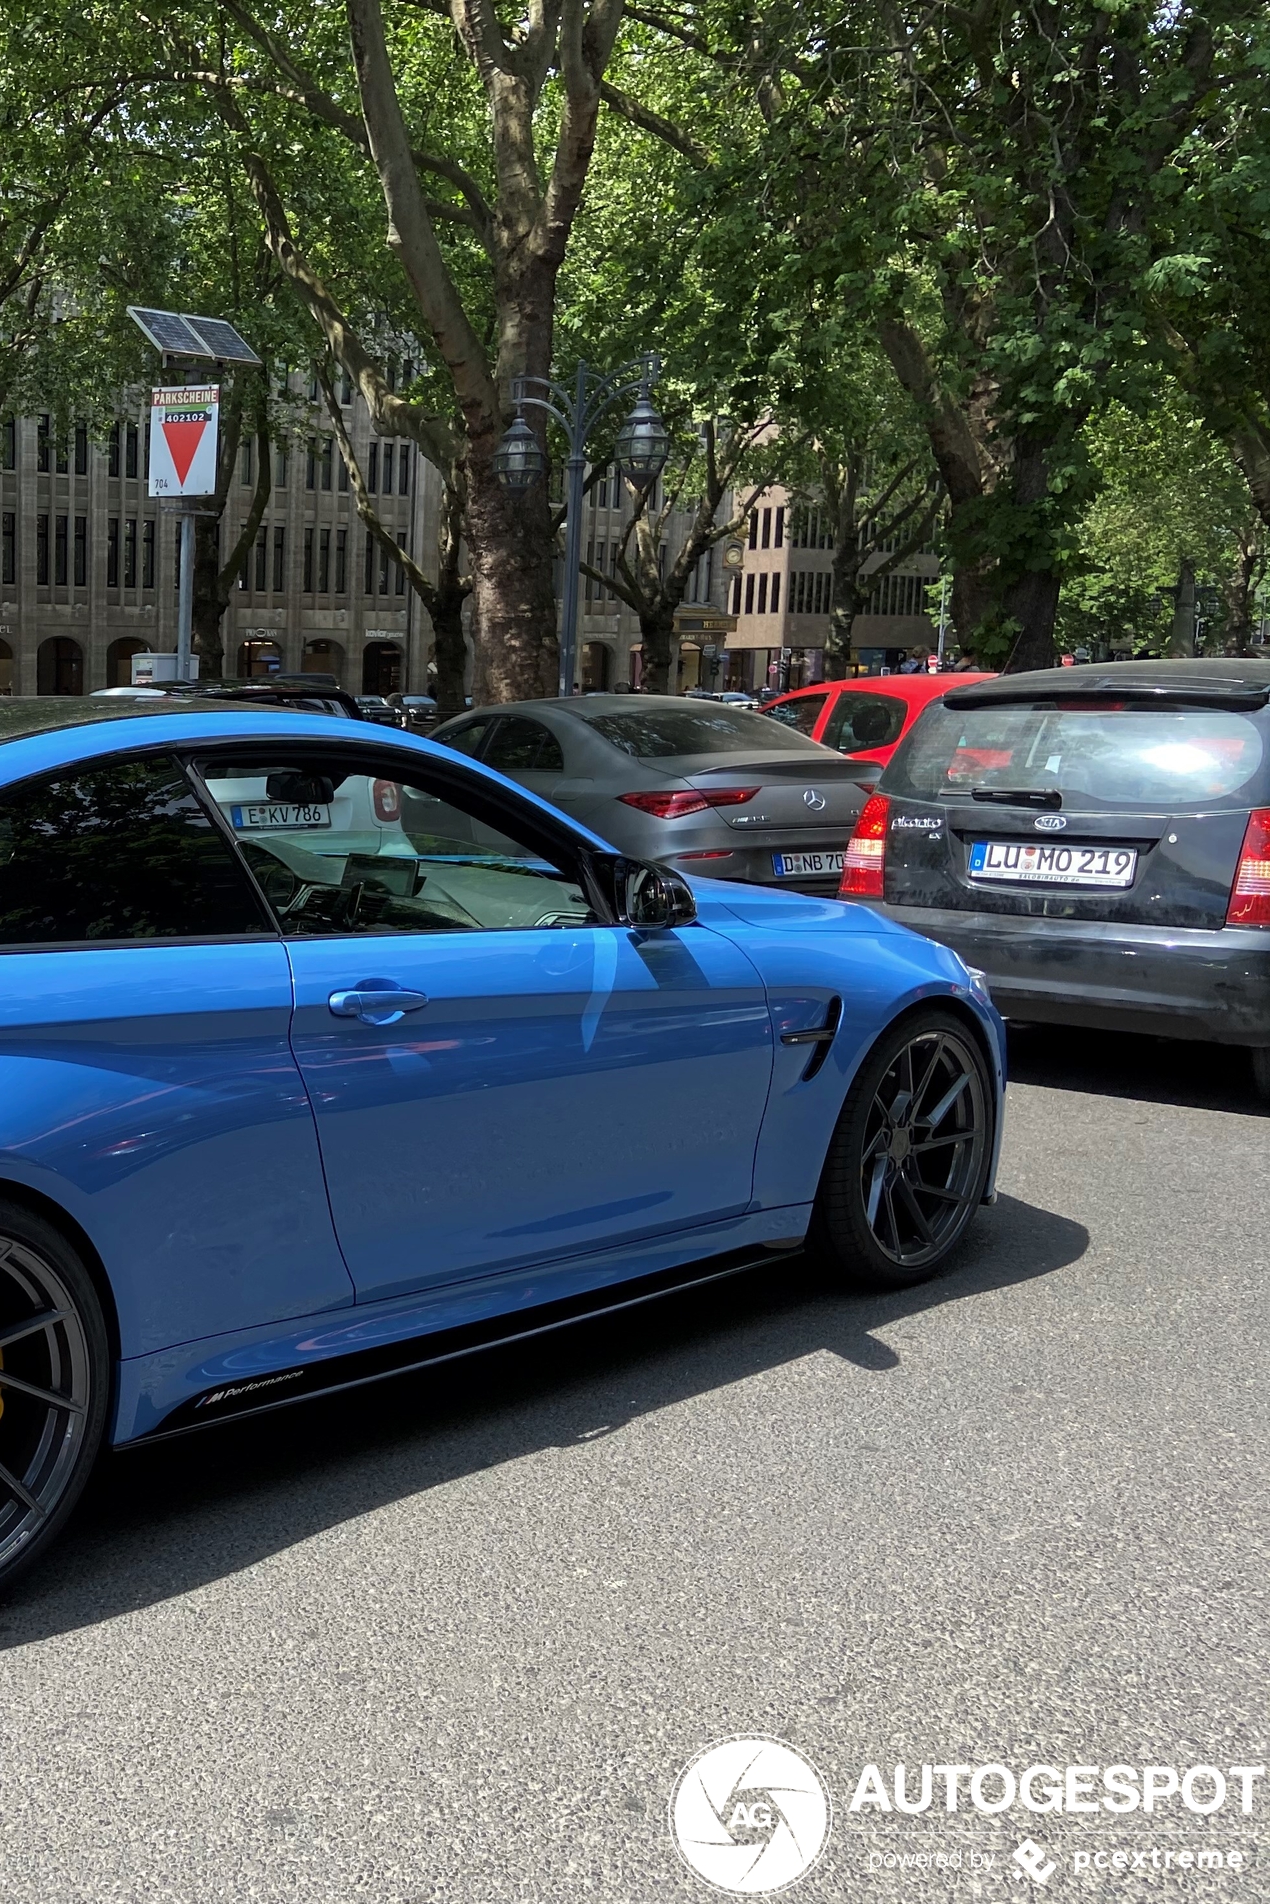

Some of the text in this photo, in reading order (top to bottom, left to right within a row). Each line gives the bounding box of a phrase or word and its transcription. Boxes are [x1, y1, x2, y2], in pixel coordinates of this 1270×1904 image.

[154, 391, 217, 404] PARKSCHEINE
[166, 413, 205, 422] 402102
[154, 479, 168, 488] 704
[248, 806, 321, 824] E KV 786
[783, 856, 794, 872] D
[802, 855, 823, 871] NB
[986, 845, 1130, 875] LU MO 219
